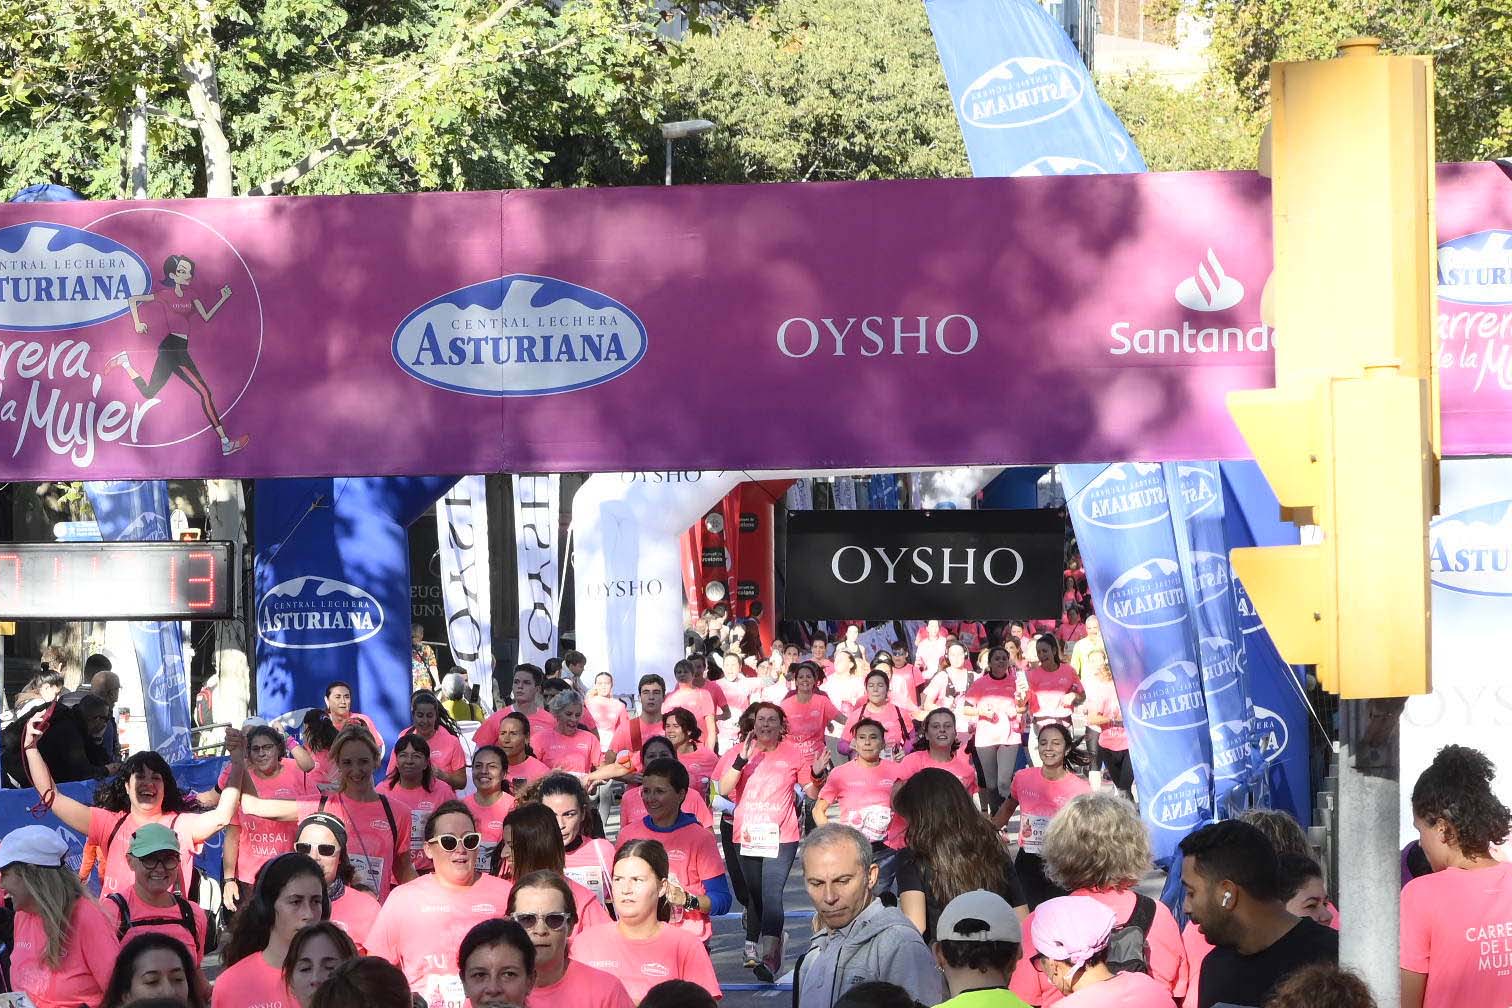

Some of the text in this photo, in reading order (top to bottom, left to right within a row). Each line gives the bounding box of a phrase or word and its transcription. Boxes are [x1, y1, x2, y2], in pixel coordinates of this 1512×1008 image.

[53, 258, 128, 271] LECHERA
[451, 314, 619, 330] CENTRAL LECHERA
[775, 314, 979, 359] OYSHO
[411, 322, 628, 367] ASTURIANA
[1109, 321, 1276, 356] Santand
[11, 372, 161, 468] Mujer
[830, 544, 1025, 588] OYSHO
[260, 605, 375, 634] ASTURIANA
[274, 599, 371, 610] CENTRAL LECHERA
[1480, 939, 1500, 956] DE
